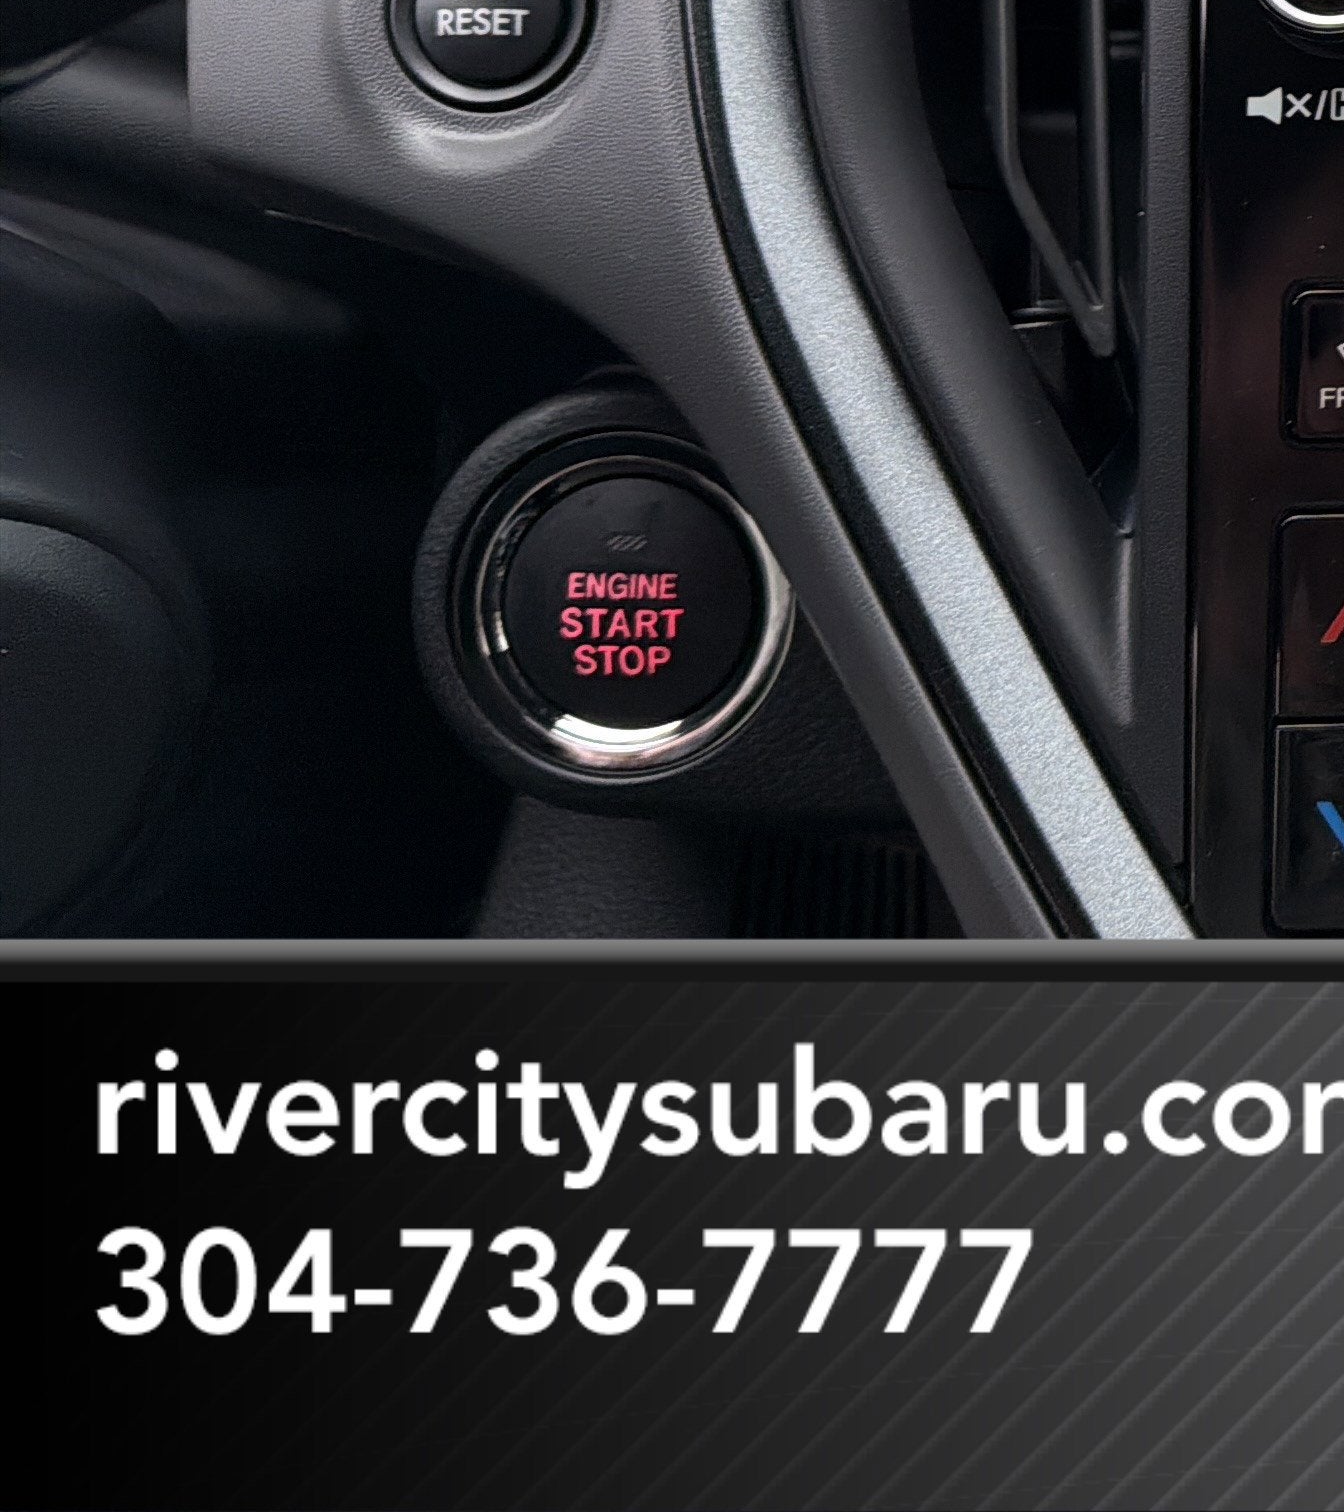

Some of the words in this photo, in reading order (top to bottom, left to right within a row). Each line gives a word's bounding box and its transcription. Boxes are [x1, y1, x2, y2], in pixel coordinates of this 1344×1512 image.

[435, 7, 530, 37] RESET
[567, 571, 678, 601] ENGINE
[559, 606, 685, 639] START
[574, 644, 672, 677] STOP
